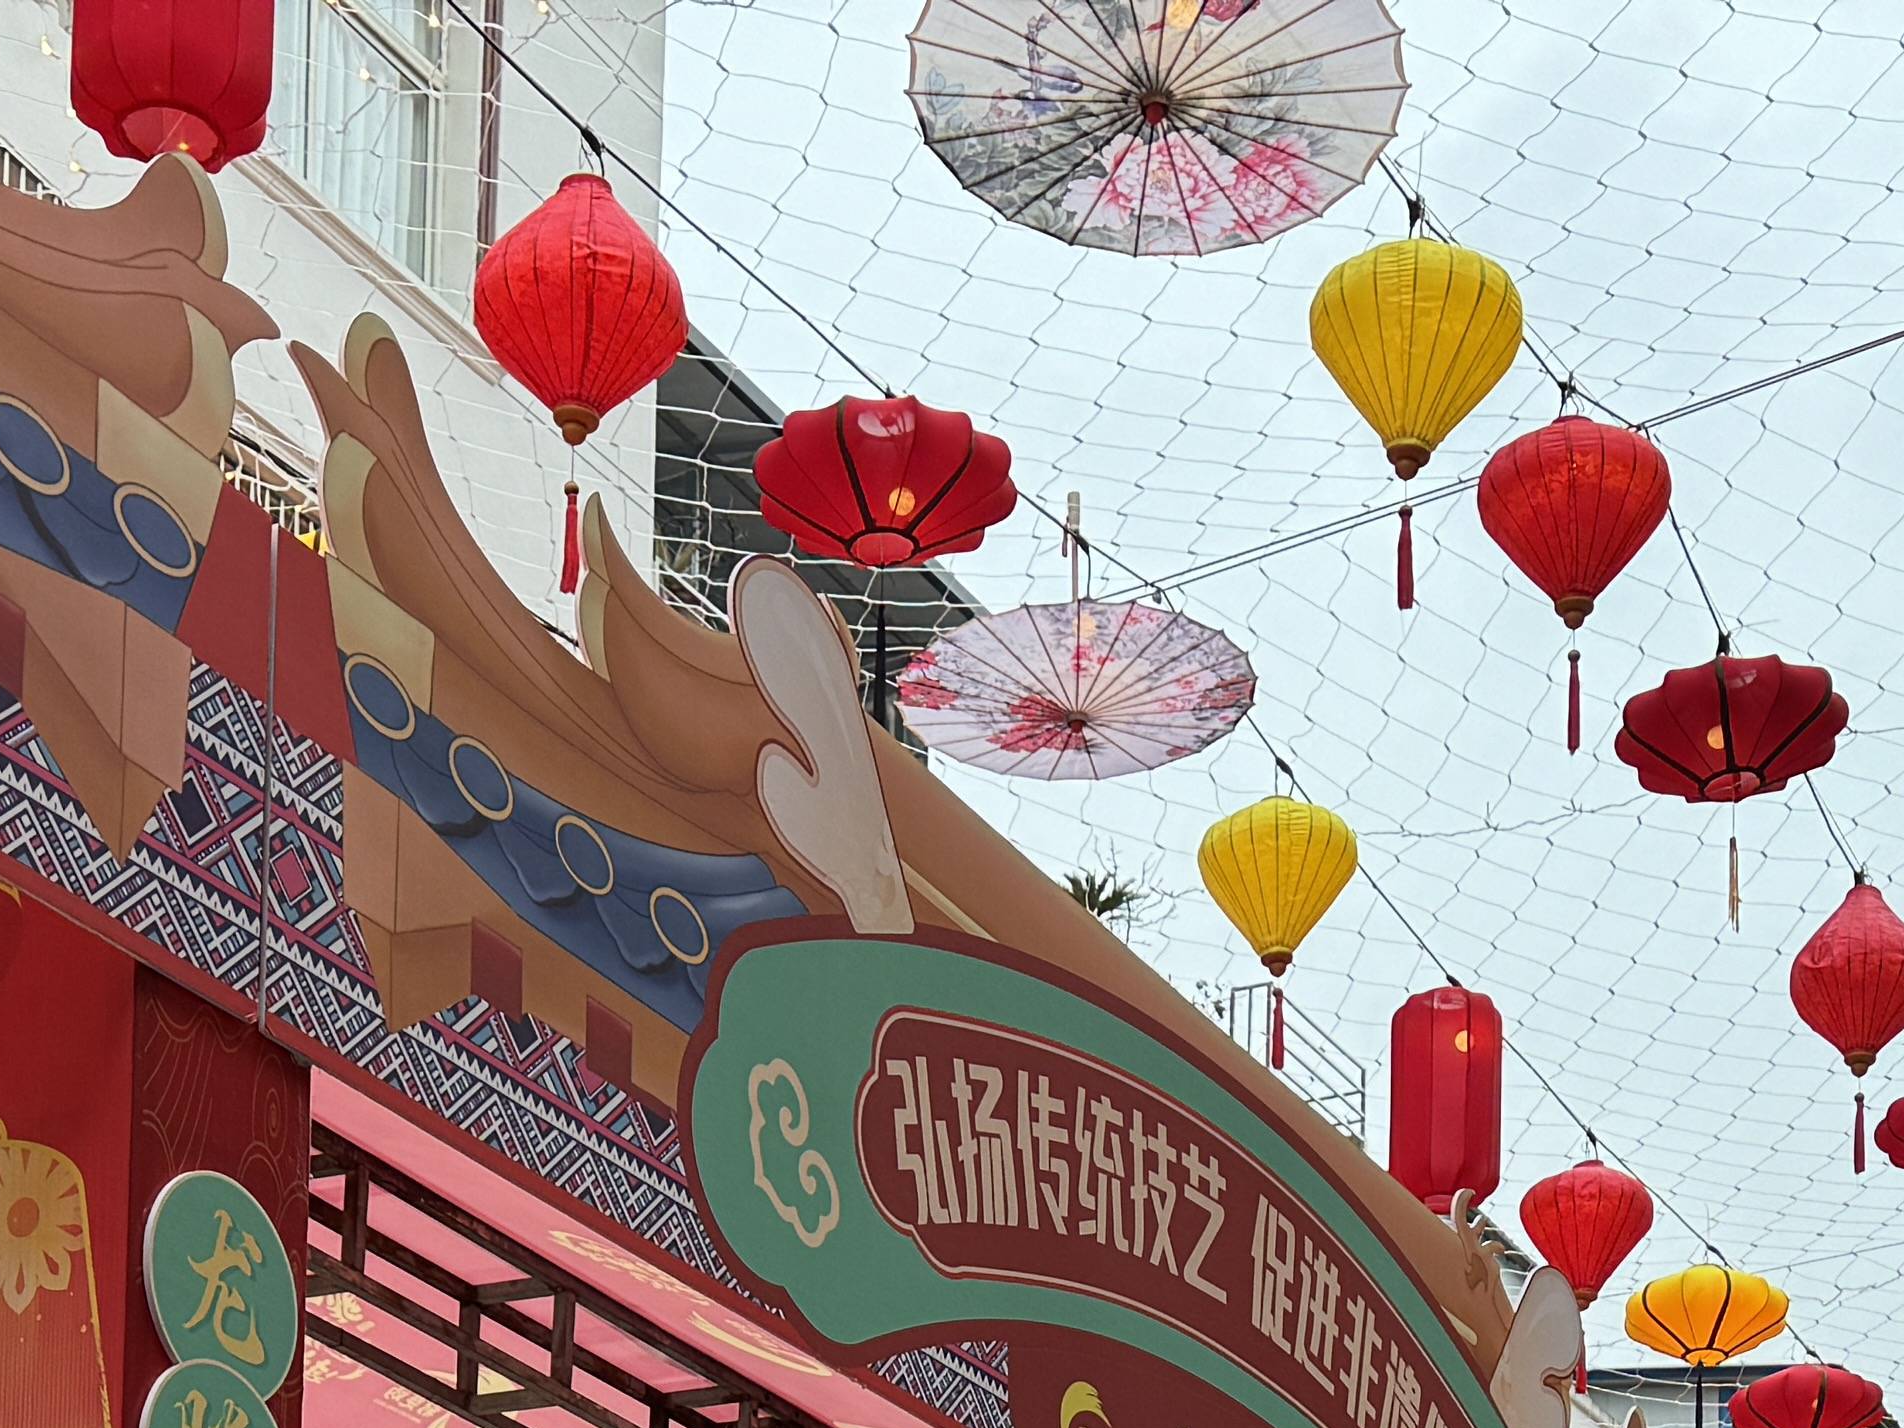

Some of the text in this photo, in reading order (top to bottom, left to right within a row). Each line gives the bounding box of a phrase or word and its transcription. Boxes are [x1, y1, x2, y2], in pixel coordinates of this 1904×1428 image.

[886, 1056, 1229, 1304] 弘扬传统技艺
